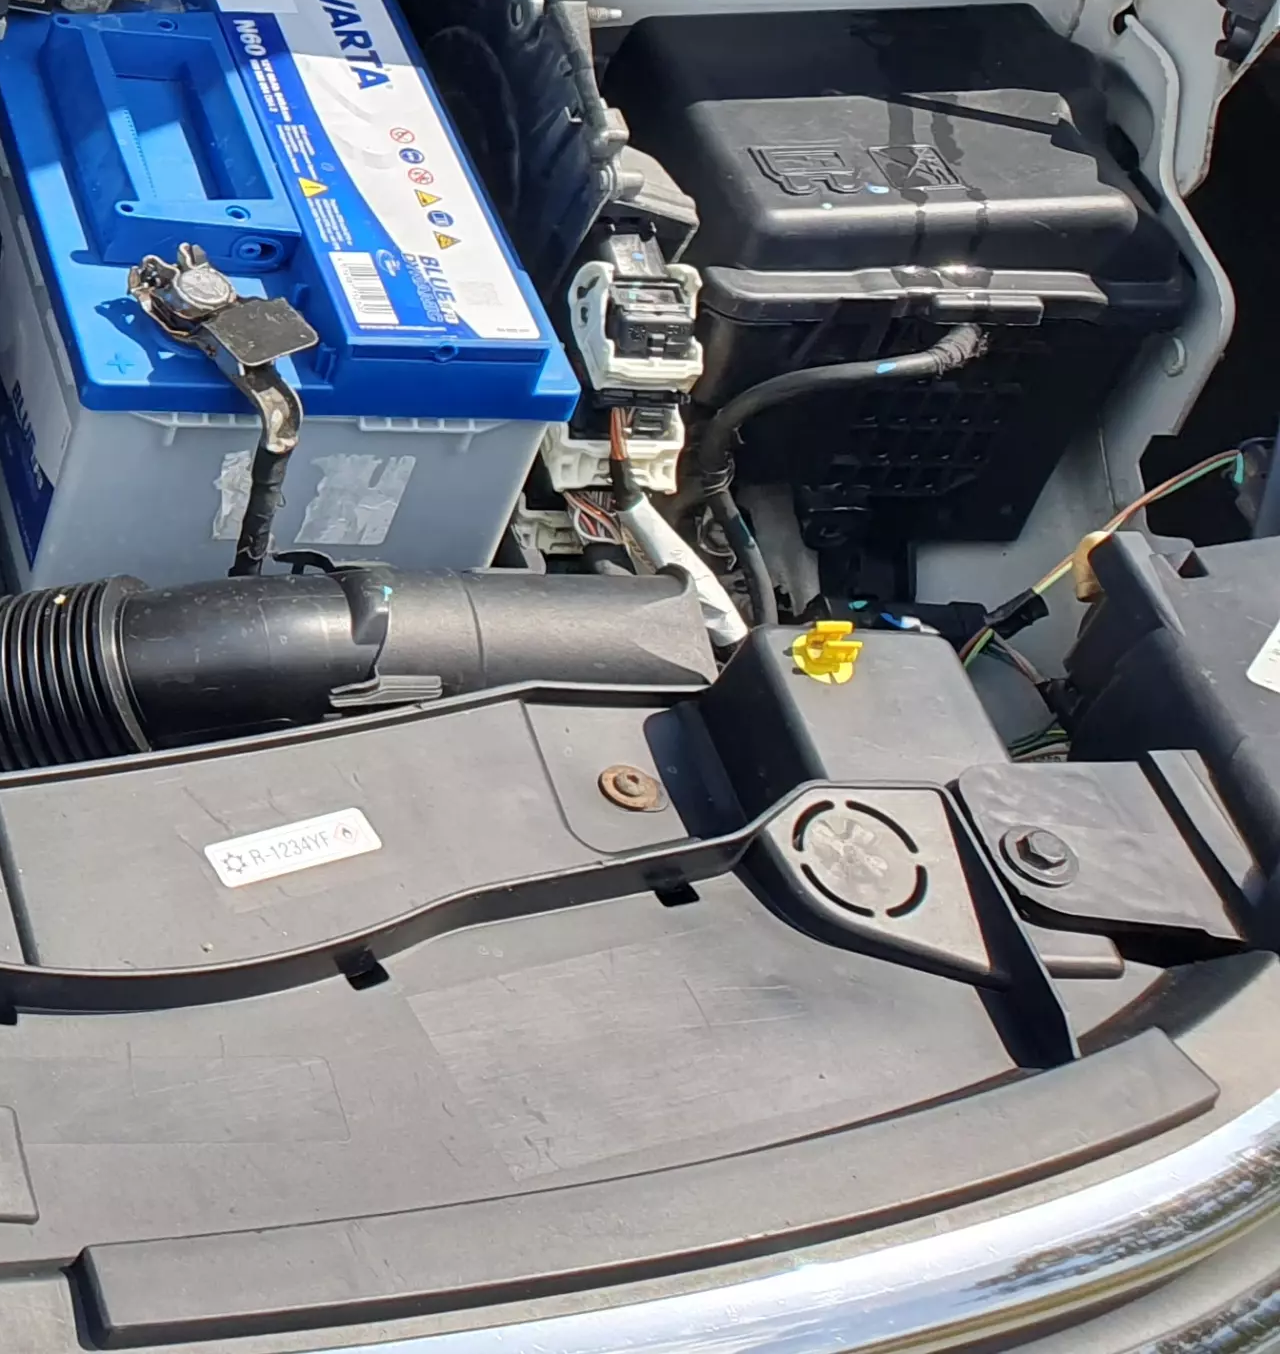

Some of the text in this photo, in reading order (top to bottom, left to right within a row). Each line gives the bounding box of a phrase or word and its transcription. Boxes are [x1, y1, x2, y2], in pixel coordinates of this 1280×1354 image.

[232, 19, 267, 57] N60
[417, 254, 457, 304] BLUE
[248, 830, 330, 868] R-1234YF
